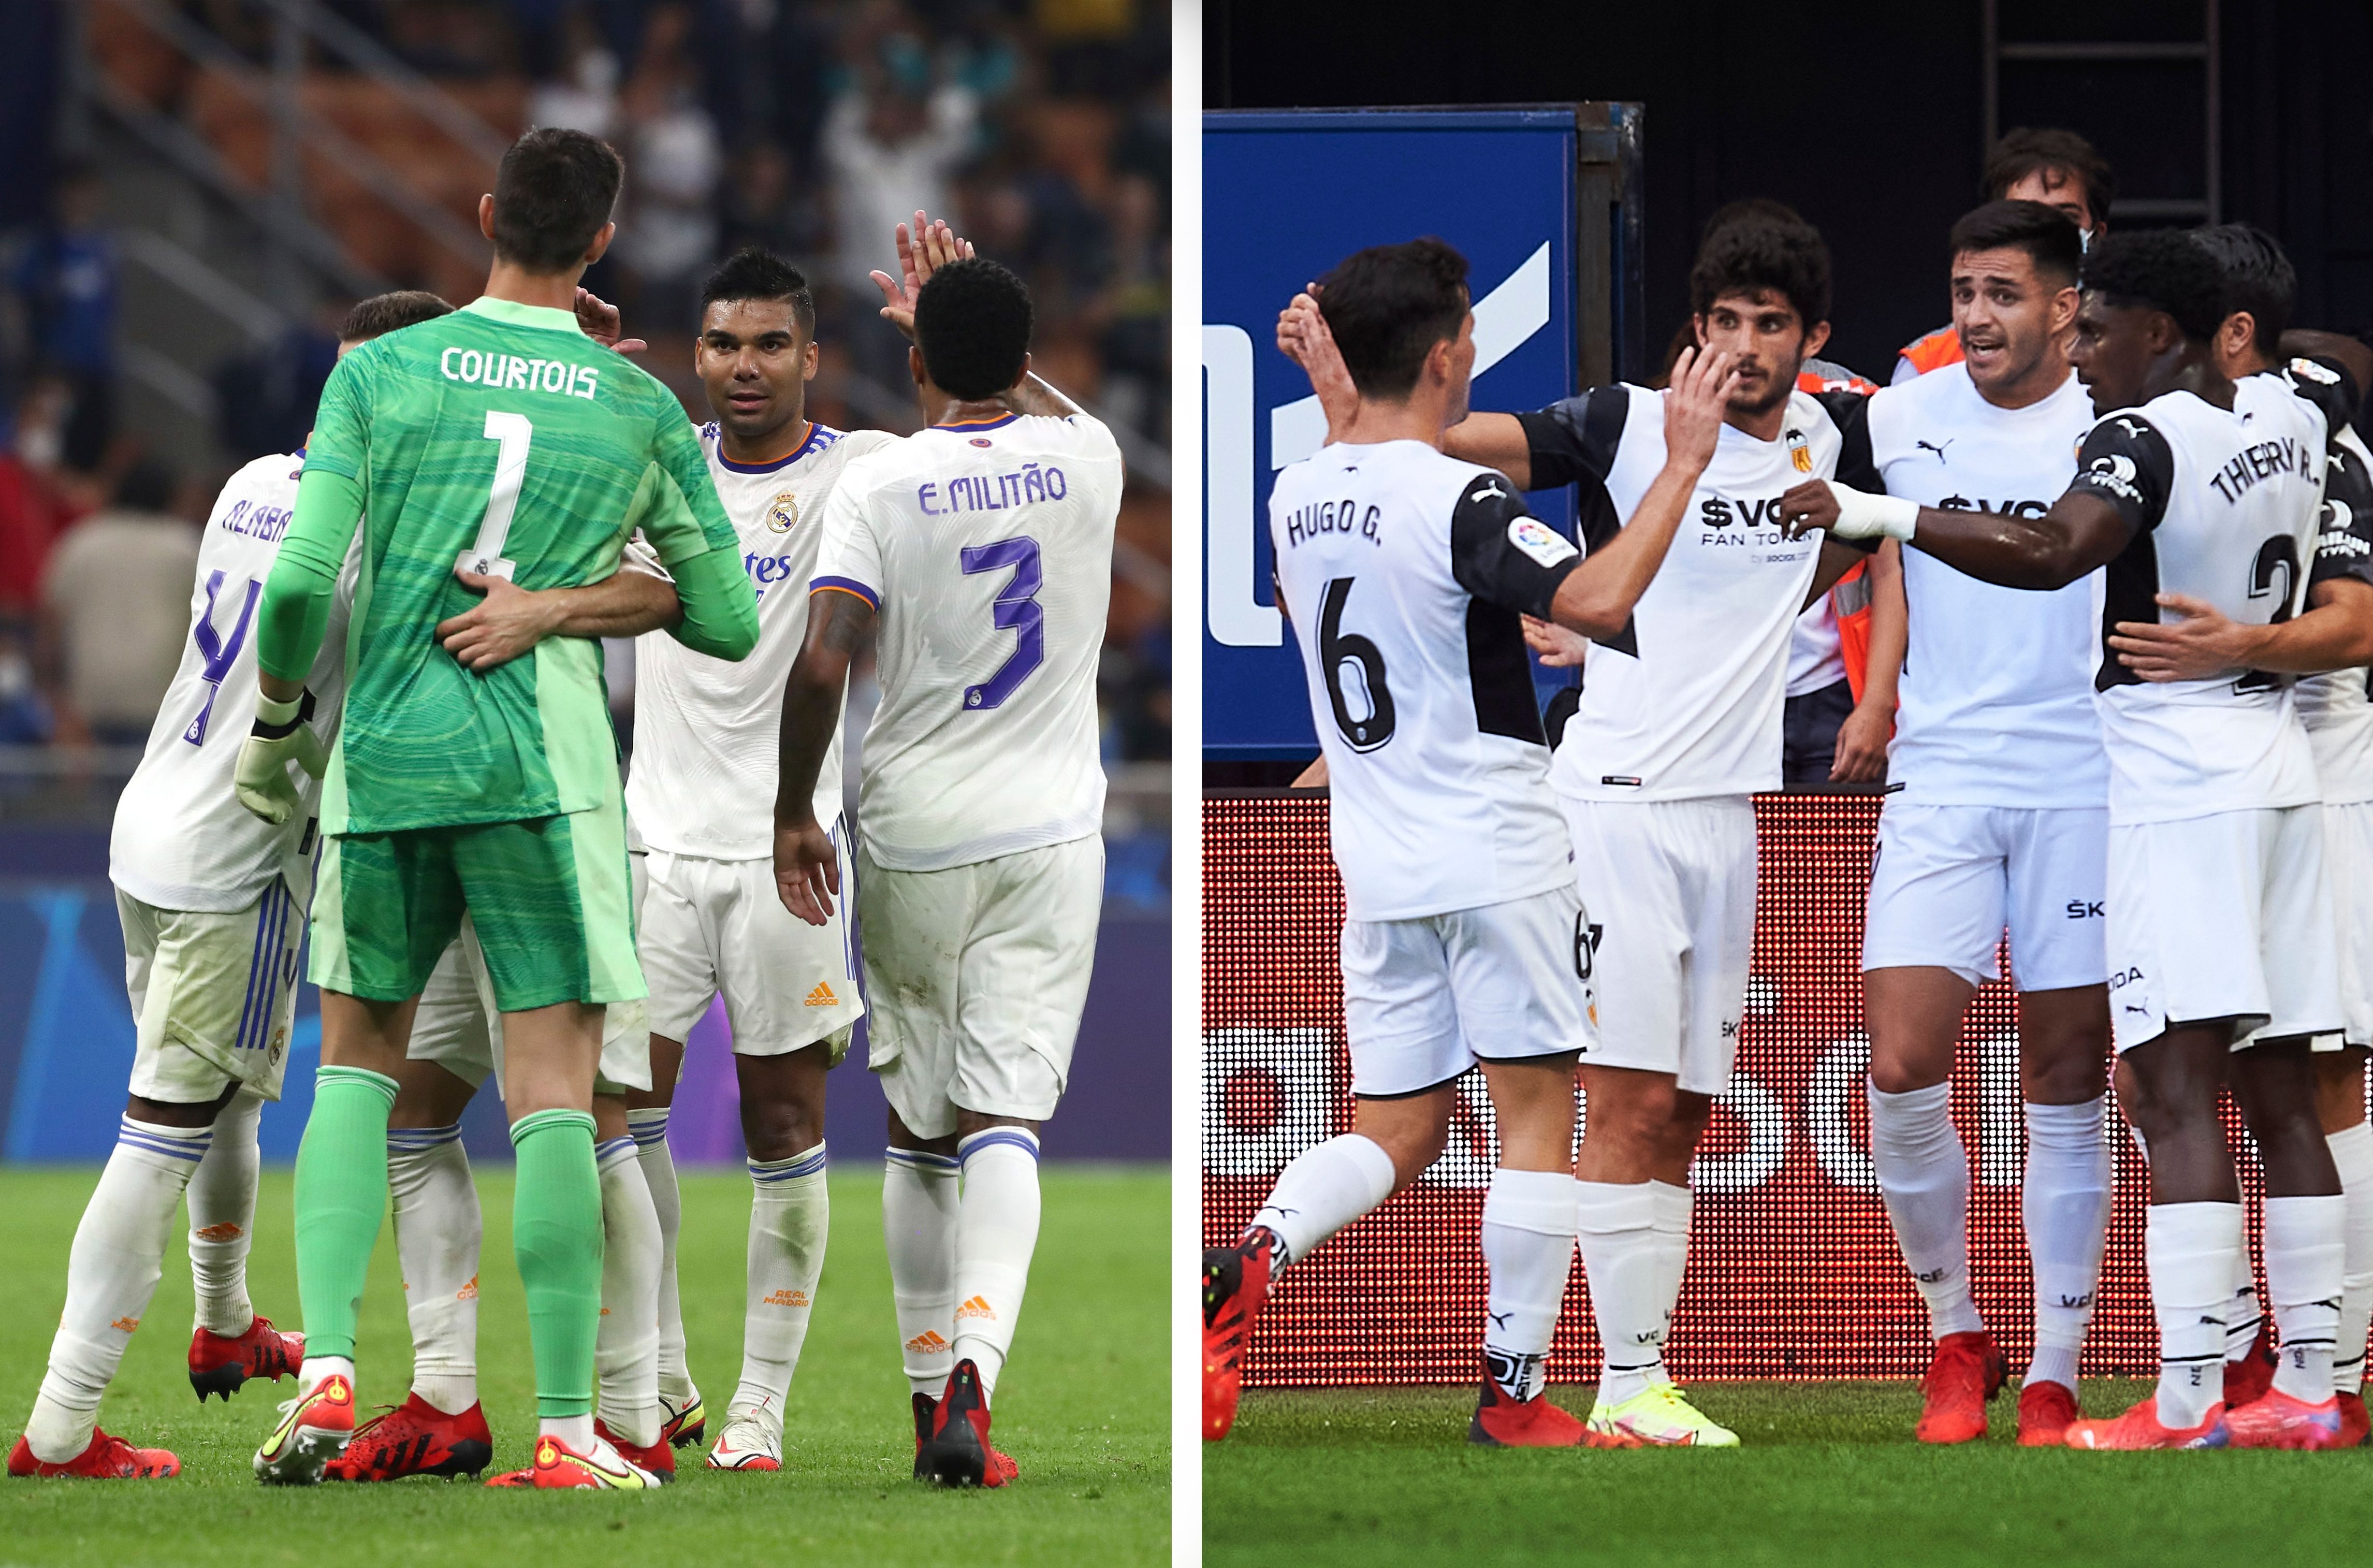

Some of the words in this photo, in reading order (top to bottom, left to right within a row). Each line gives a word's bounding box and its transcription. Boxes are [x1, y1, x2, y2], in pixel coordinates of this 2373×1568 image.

[441, 347, 599, 400] COURTOIS
[453, 410, 533, 583] 1
[918, 462, 1067, 516] E.MILITÃO
[2210, 437, 2295, 505] THIERRY
[2299, 445, 2320, 486] R.
[223, 500, 294, 543] ALABA
[1287, 500, 1355, 549] HUGO
[1362, 504, 1381, 546] G.
[1701, 496, 1784, 531] $VC
[1701, 533, 1744, 545] FAN
[744, 550, 791, 583] tes
[960, 535, 1044, 710] 3
[2232, 534, 2303, 695] 2
[183, 569, 263, 747] 4
[1315, 576, 1395, 754] 6
[2067, 899, 2105, 919] ŠK
[804, 997, 839, 1006] adidas
[905, 1342, 953, 1355] adidas
